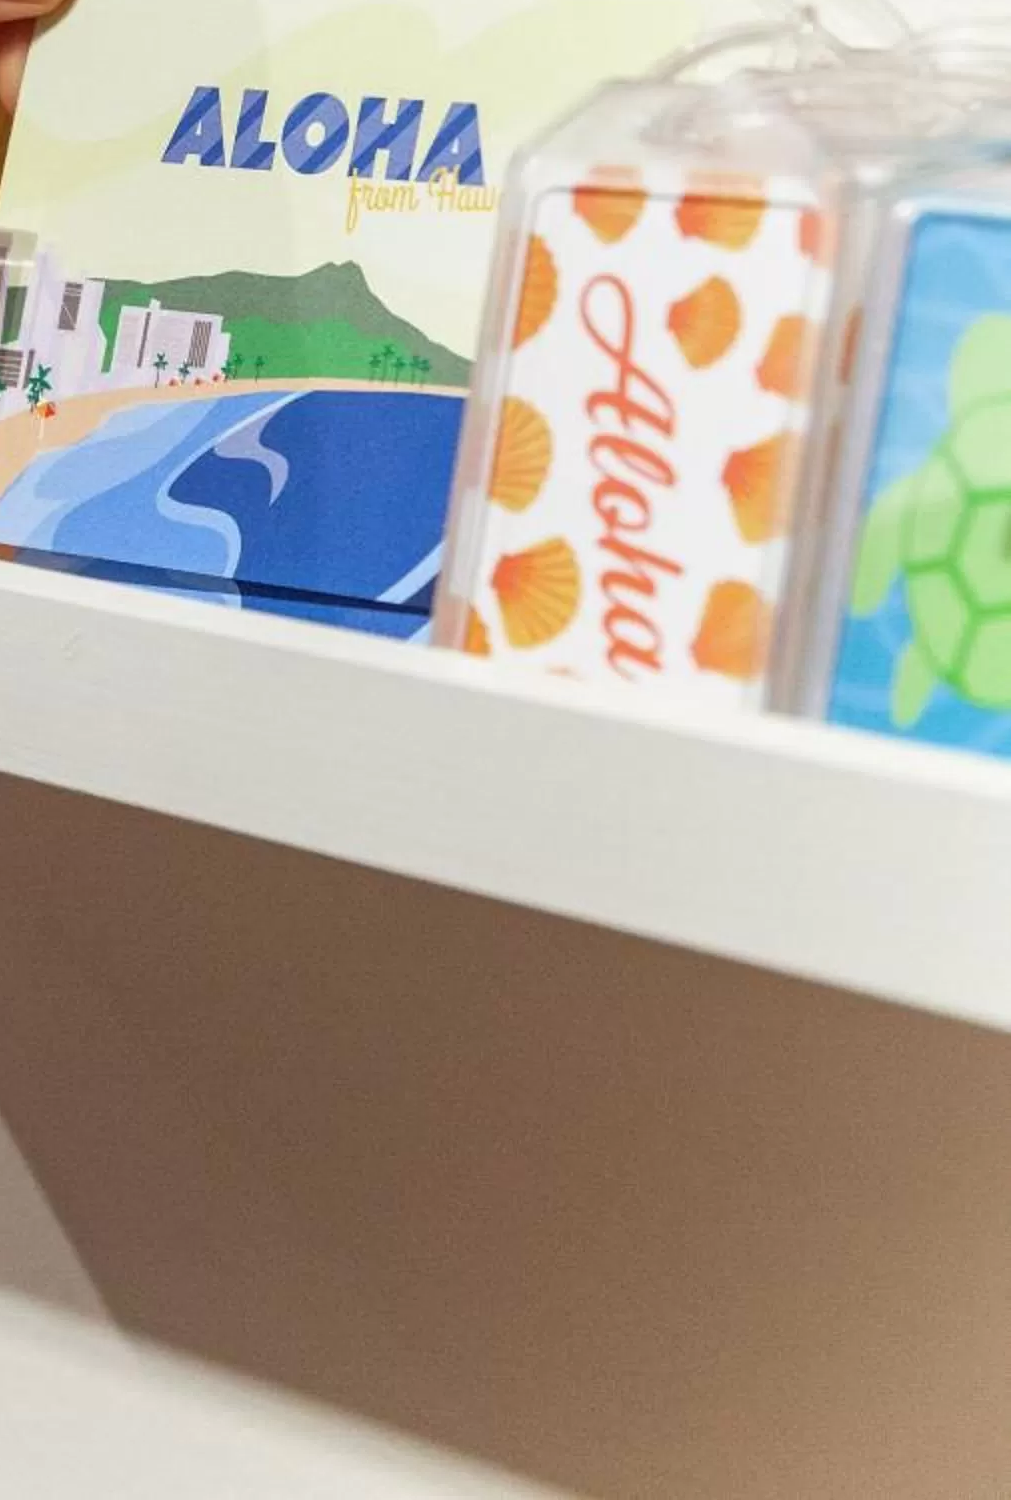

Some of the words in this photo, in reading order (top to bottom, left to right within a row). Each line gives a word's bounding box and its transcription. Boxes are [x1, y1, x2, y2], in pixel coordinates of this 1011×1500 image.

[161, 84, 487, 186] ALOHA
[345, 168, 420, 235] from
[428, 164, 501, 212] Haw
[577, 272, 685, 684] Aloha
